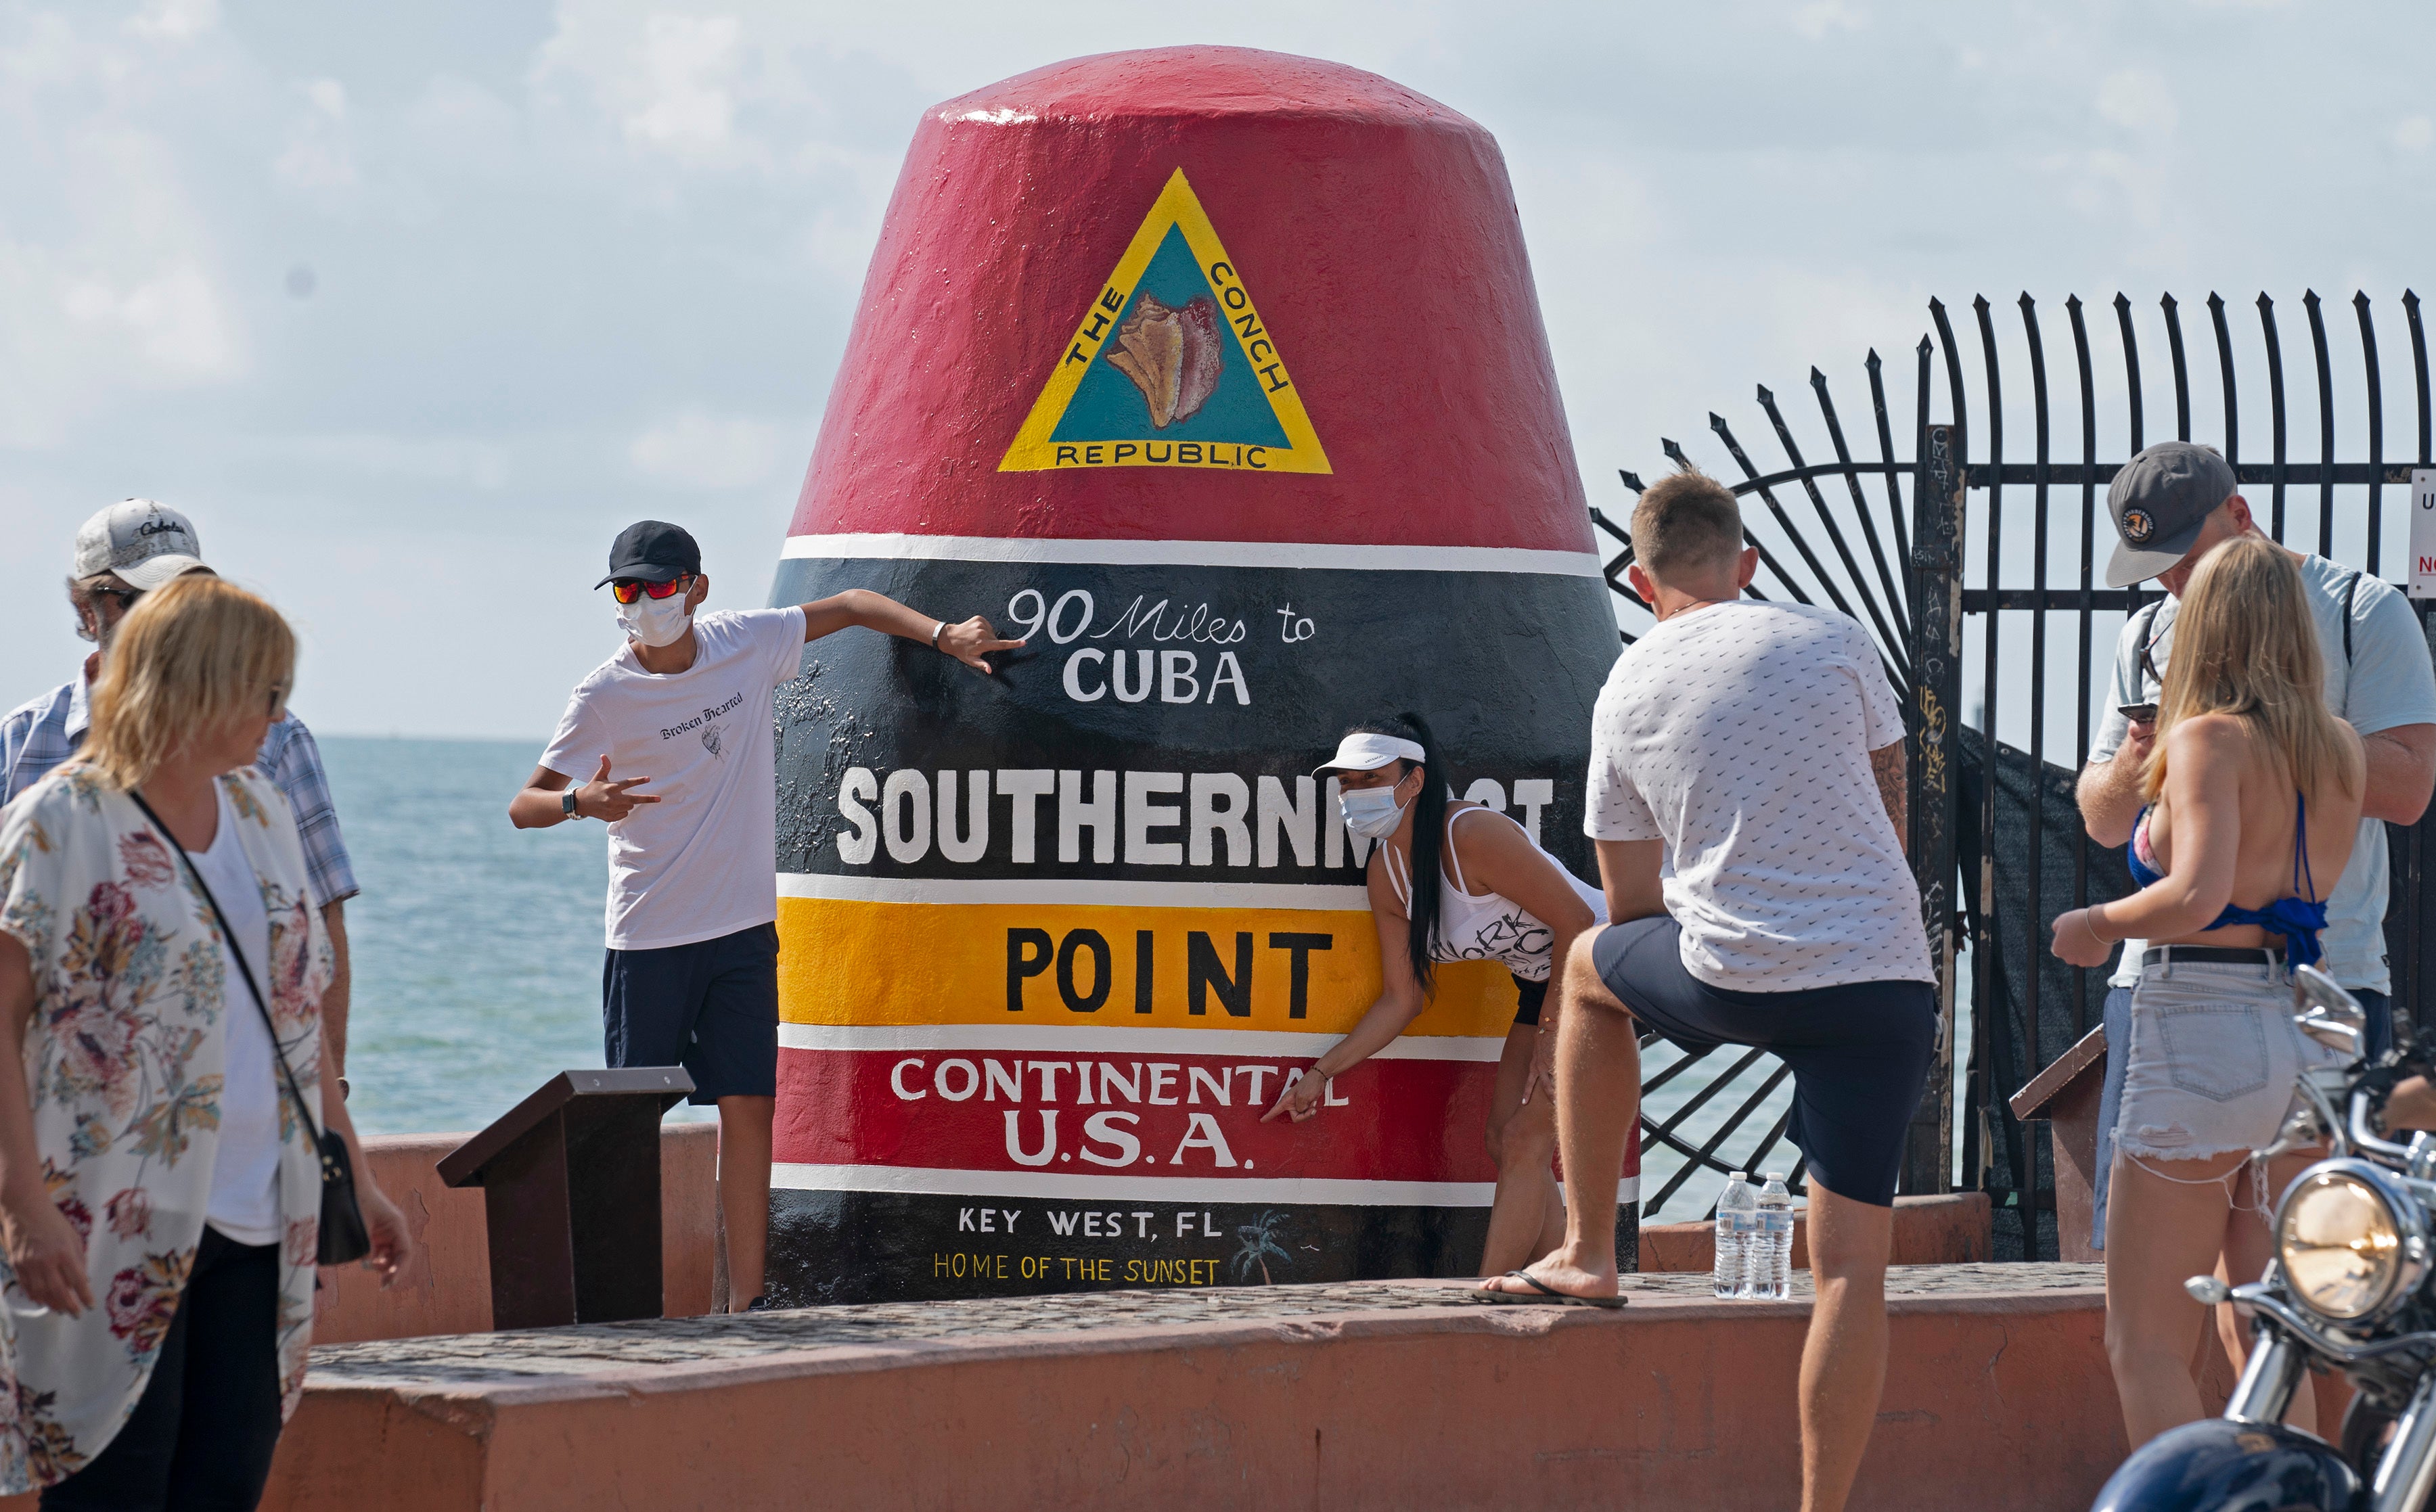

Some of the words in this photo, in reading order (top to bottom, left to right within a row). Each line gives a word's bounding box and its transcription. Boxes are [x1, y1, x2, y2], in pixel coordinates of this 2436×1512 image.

[1065, 287, 1125, 367] THE
[1210, 262, 1289, 393] CONCH
[1056, 442, 1267, 468] REPUBLIC
[2422, 492, 2436, 509] U
[2419, 556, 2436, 572] N
[1008, 589, 1093, 644] 90
[1089, 595, 1246, 643] Miles
[1278, 602, 1315, 643] to
[1062, 647, 1251, 705] CUBA
[660, 716, 702, 741] Broken
[702, 691, 743, 722] Hearted
[1006, 927, 1333, 1019] POINT
[1004, 1109, 1254, 1169] U.S.A.
[959, 1208, 1021, 1233] KEY
[1047, 1211, 1158, 1242] WEST,
[1176, 1212, 1222, 1237] FL
[934, 1253, 1008, 1278] HOME
[1020, 1256, 1051, 1279] OF
[1060, 1258, 1112, 1281] THE
[1124, 1260, 1220, 1285] SUNSET
